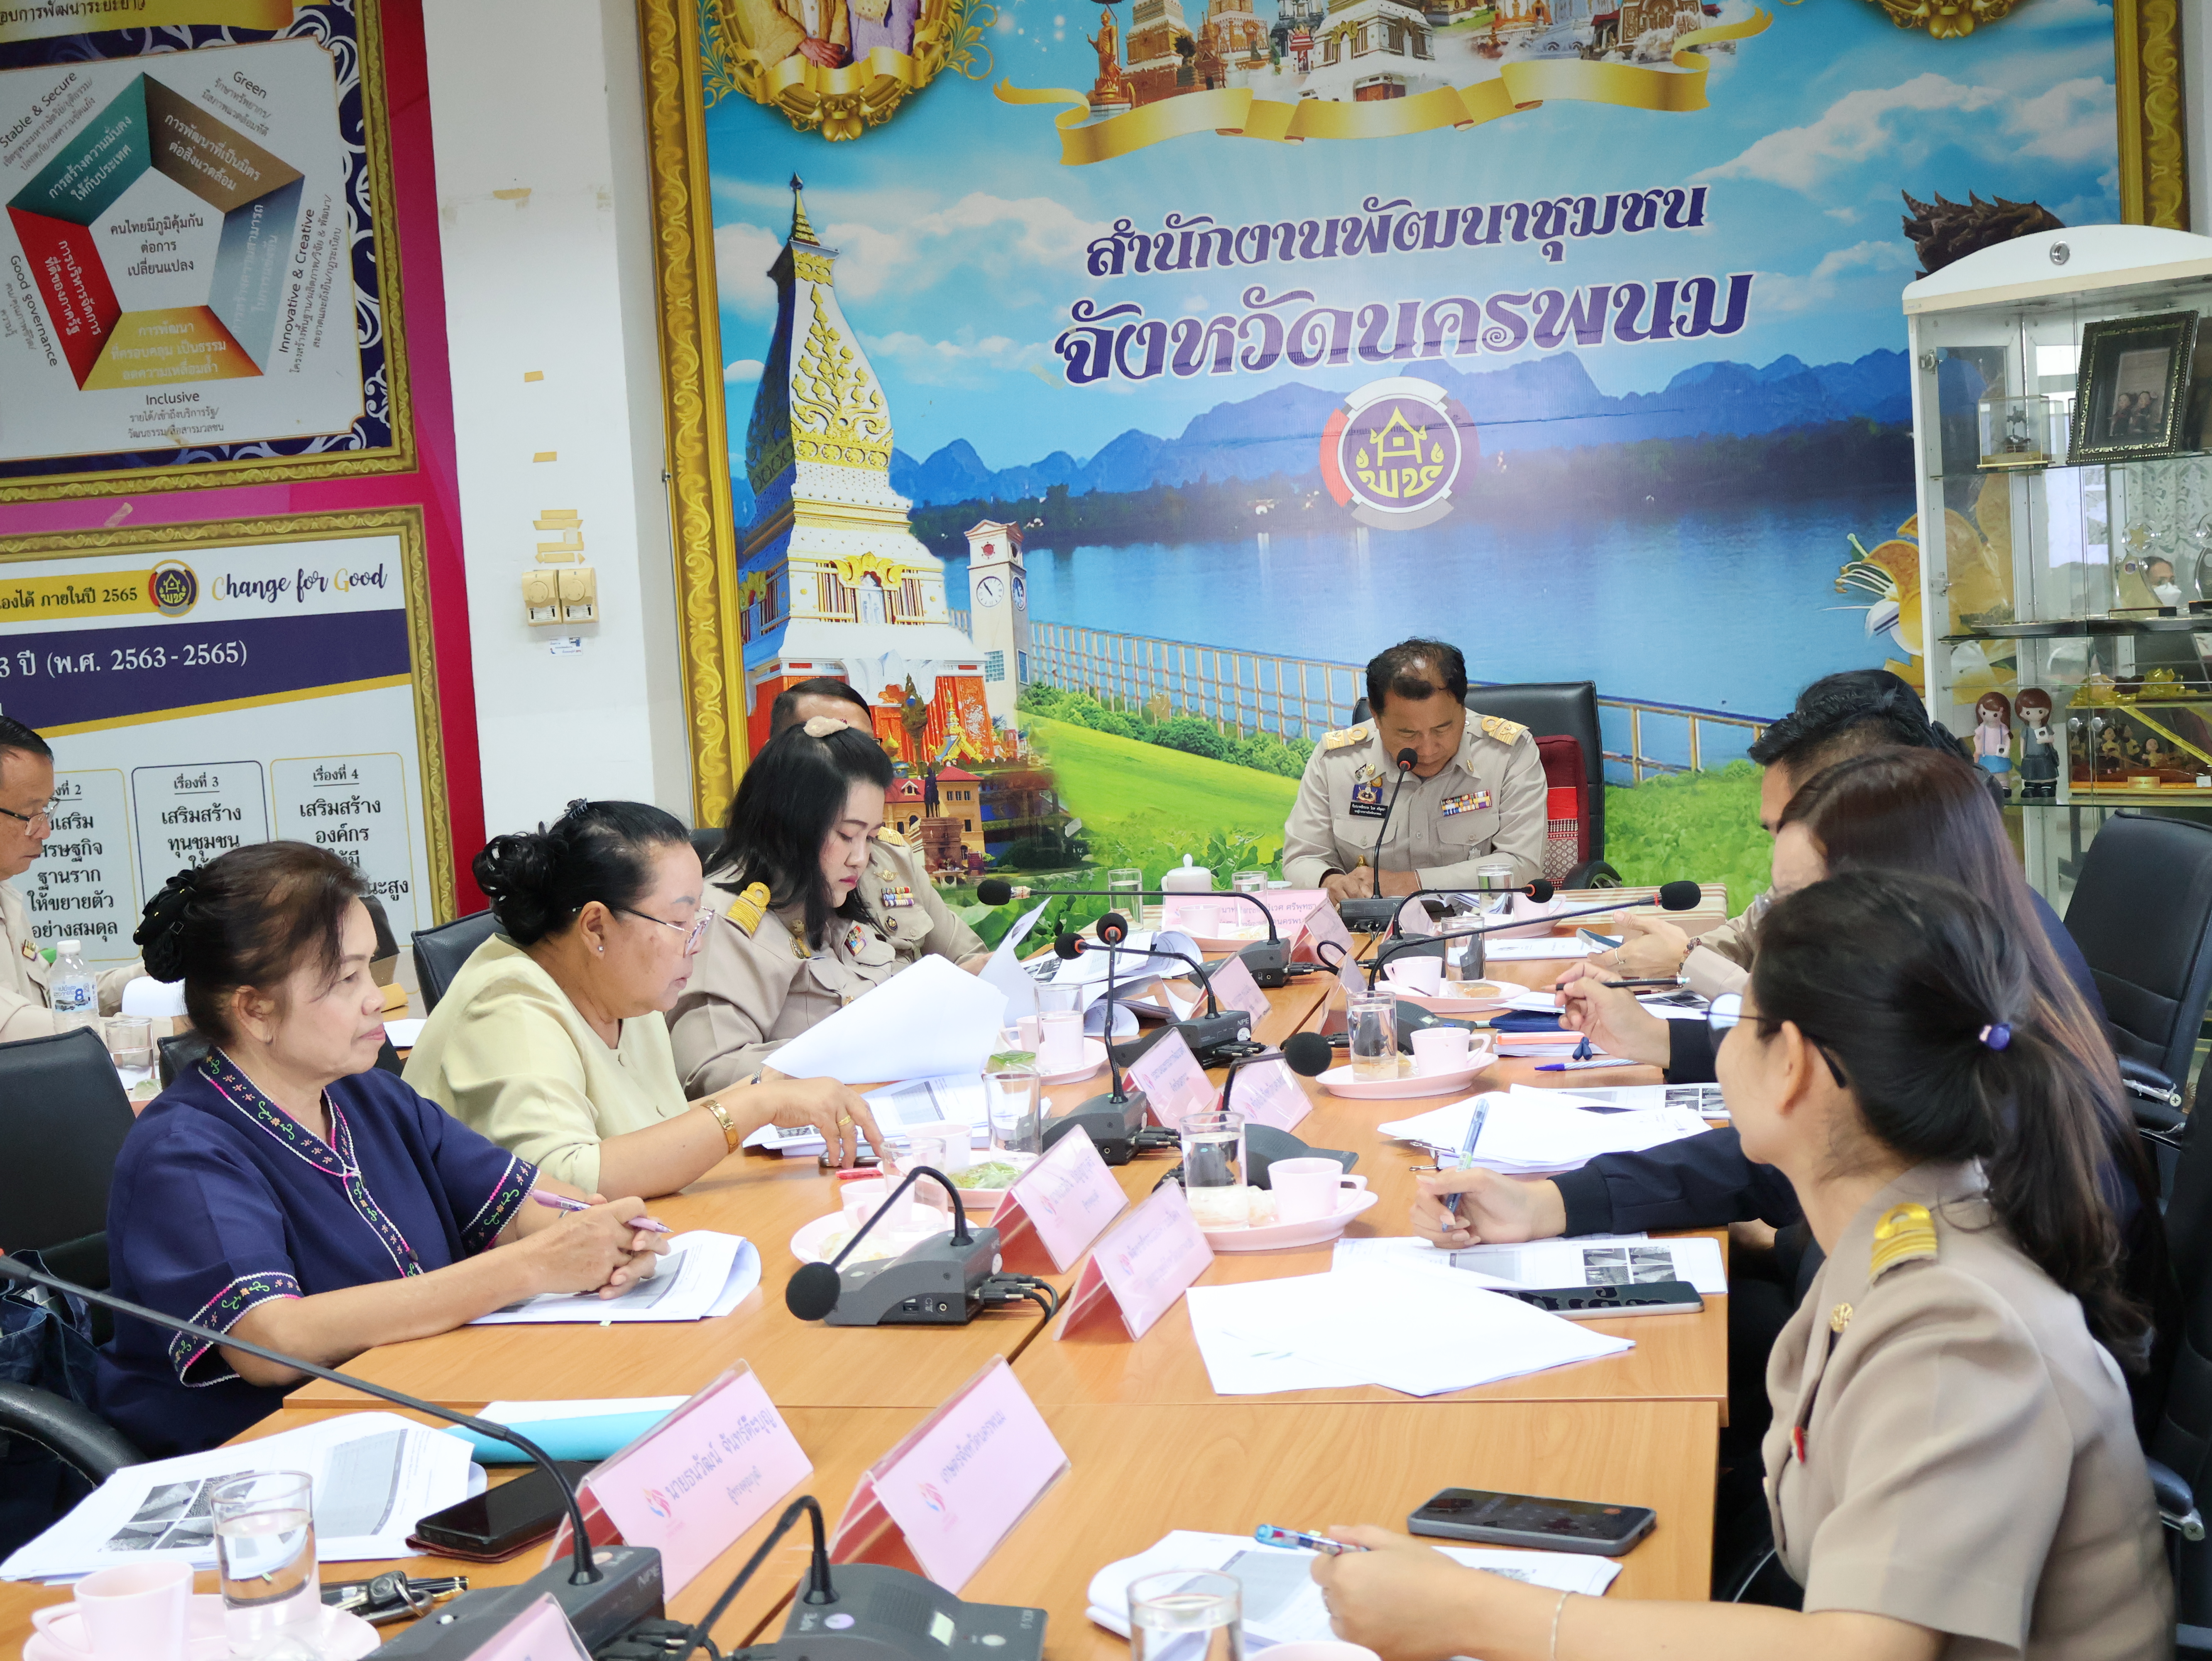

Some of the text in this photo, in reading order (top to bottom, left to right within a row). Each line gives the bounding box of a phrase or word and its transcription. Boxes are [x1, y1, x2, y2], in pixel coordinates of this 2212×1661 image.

[0, 0, 145, 23] อบการพัฒนาระยะยาว
[233, 71, 267, 99] Green
[0, 73, 77, 148] Stable & Secure
[49, 116, 132, 198] การสร้างความมั่นคง
[165, 115, 261, 181] การพัฒนาที่เป็นมิตร
[71, 144, 132, 201] ให้กับประเทศ
[169, 141, 237, 191] ต่อสิ่งแวดล้อม
[111, 216, 203, 235] คนไทยมีภูมิคุ้มกัน
[1087, 186, 1708, 277] สำนักงานพัฒนาชุมชน
[141, 240, 176, 254] ต่อการ
[127, 258, 194, 277] เปลี่ยนแปลง
[58, 240, 101, 335] การบริหารจัดการ
[279, 209, 315, 353] Innovative & Creative
[45, 256, 82, 336] ที่ดีของภาครัฐ
[11, 255, 57, 366] Good governance
[139, 320, 194, 336] การพัฒนา
[1055, 273, 1754, 385] จังหวัดนครพนม
[146, 392, 200, 405] Inclusive
[212, 563, 387, 603] Change for Good
[0, 586, 137, 609] องได้ ภายในปี 2565
[17, 649, 37, 676] ปี
[46, 652, 101, 678] (พ.ศ.
[174, 772, 219, 789] เรื่องที่ 3
[313, 764, 359, 782] เรื่องที่ 4
[55, 780, 81, 796] งที่ 2
[162, 803, 242, 824] เสริมสร้าง
[300, 795, 381, 817] เสริมสร้าง
[51, 812, 93, 830] เสริม
[316, 823, 369, 843] องค์กร
[43, 838, 103, 862] รษฐกิจ
[168, 835, 240, 858] ทุนชุมชน
[38, 869, 100, 890] ฐานราก
[27, 890, 113, 911] ให้ขยายตัว
[1287, 903, 1316, 914] ศรีพุทธา
[32, 921, 117, 942] อย่างสมดุล
[75, 988, 83, 1001] 8
[665, 1441, 723, 1500] นายธนวัฒน์
